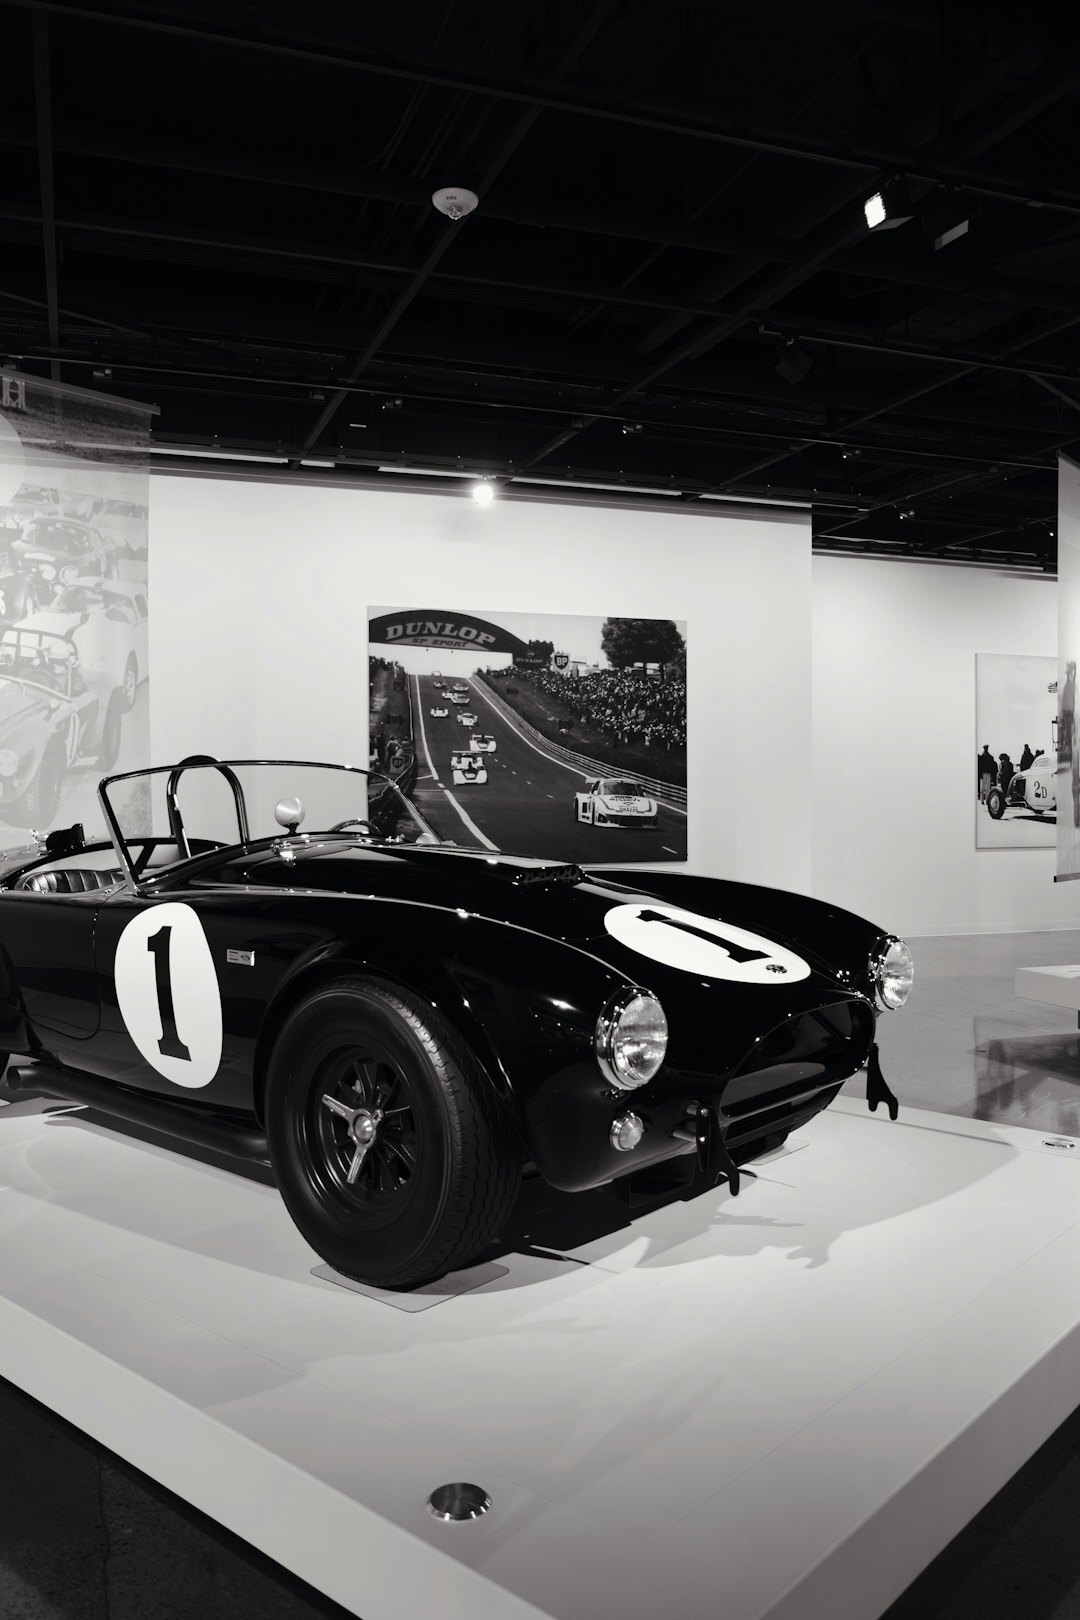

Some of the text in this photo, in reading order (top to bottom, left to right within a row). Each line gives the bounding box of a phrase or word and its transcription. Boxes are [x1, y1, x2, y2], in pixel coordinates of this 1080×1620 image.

[386, 622, 496, 644] DUNLOP
[431, 639, 468, 648] SPORT
[636, 909, 774, 964] 1
[147, 925, 192, 1062] 1
